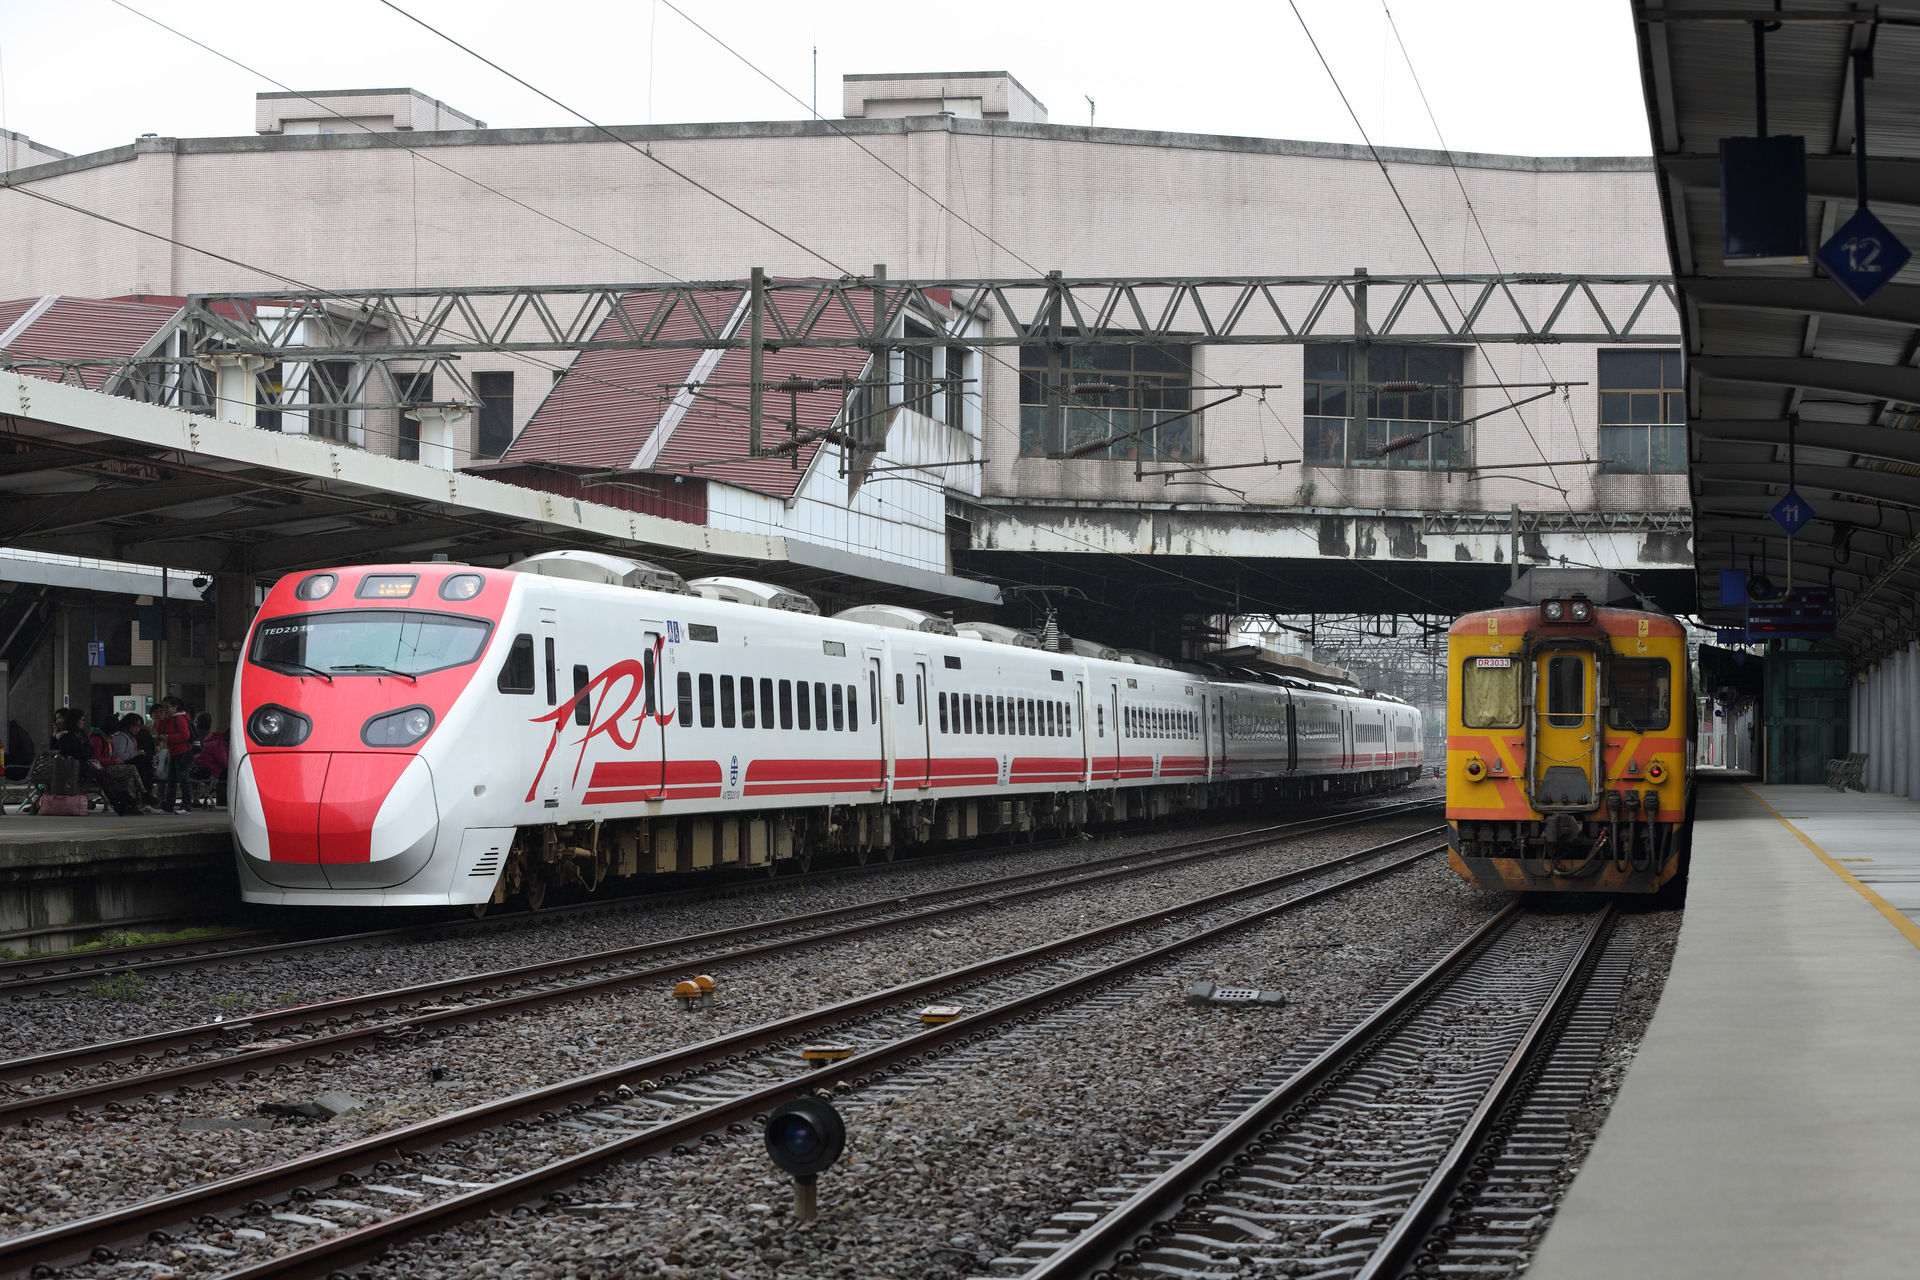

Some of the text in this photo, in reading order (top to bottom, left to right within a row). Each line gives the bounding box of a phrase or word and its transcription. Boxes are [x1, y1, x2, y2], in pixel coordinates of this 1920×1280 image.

[1841, 238, 1881, 272] 12
[1782, 504, 1799, 522] 11
[90, 652, 96, 665] 7
[1478, 659, 1509, 667] DR3033
